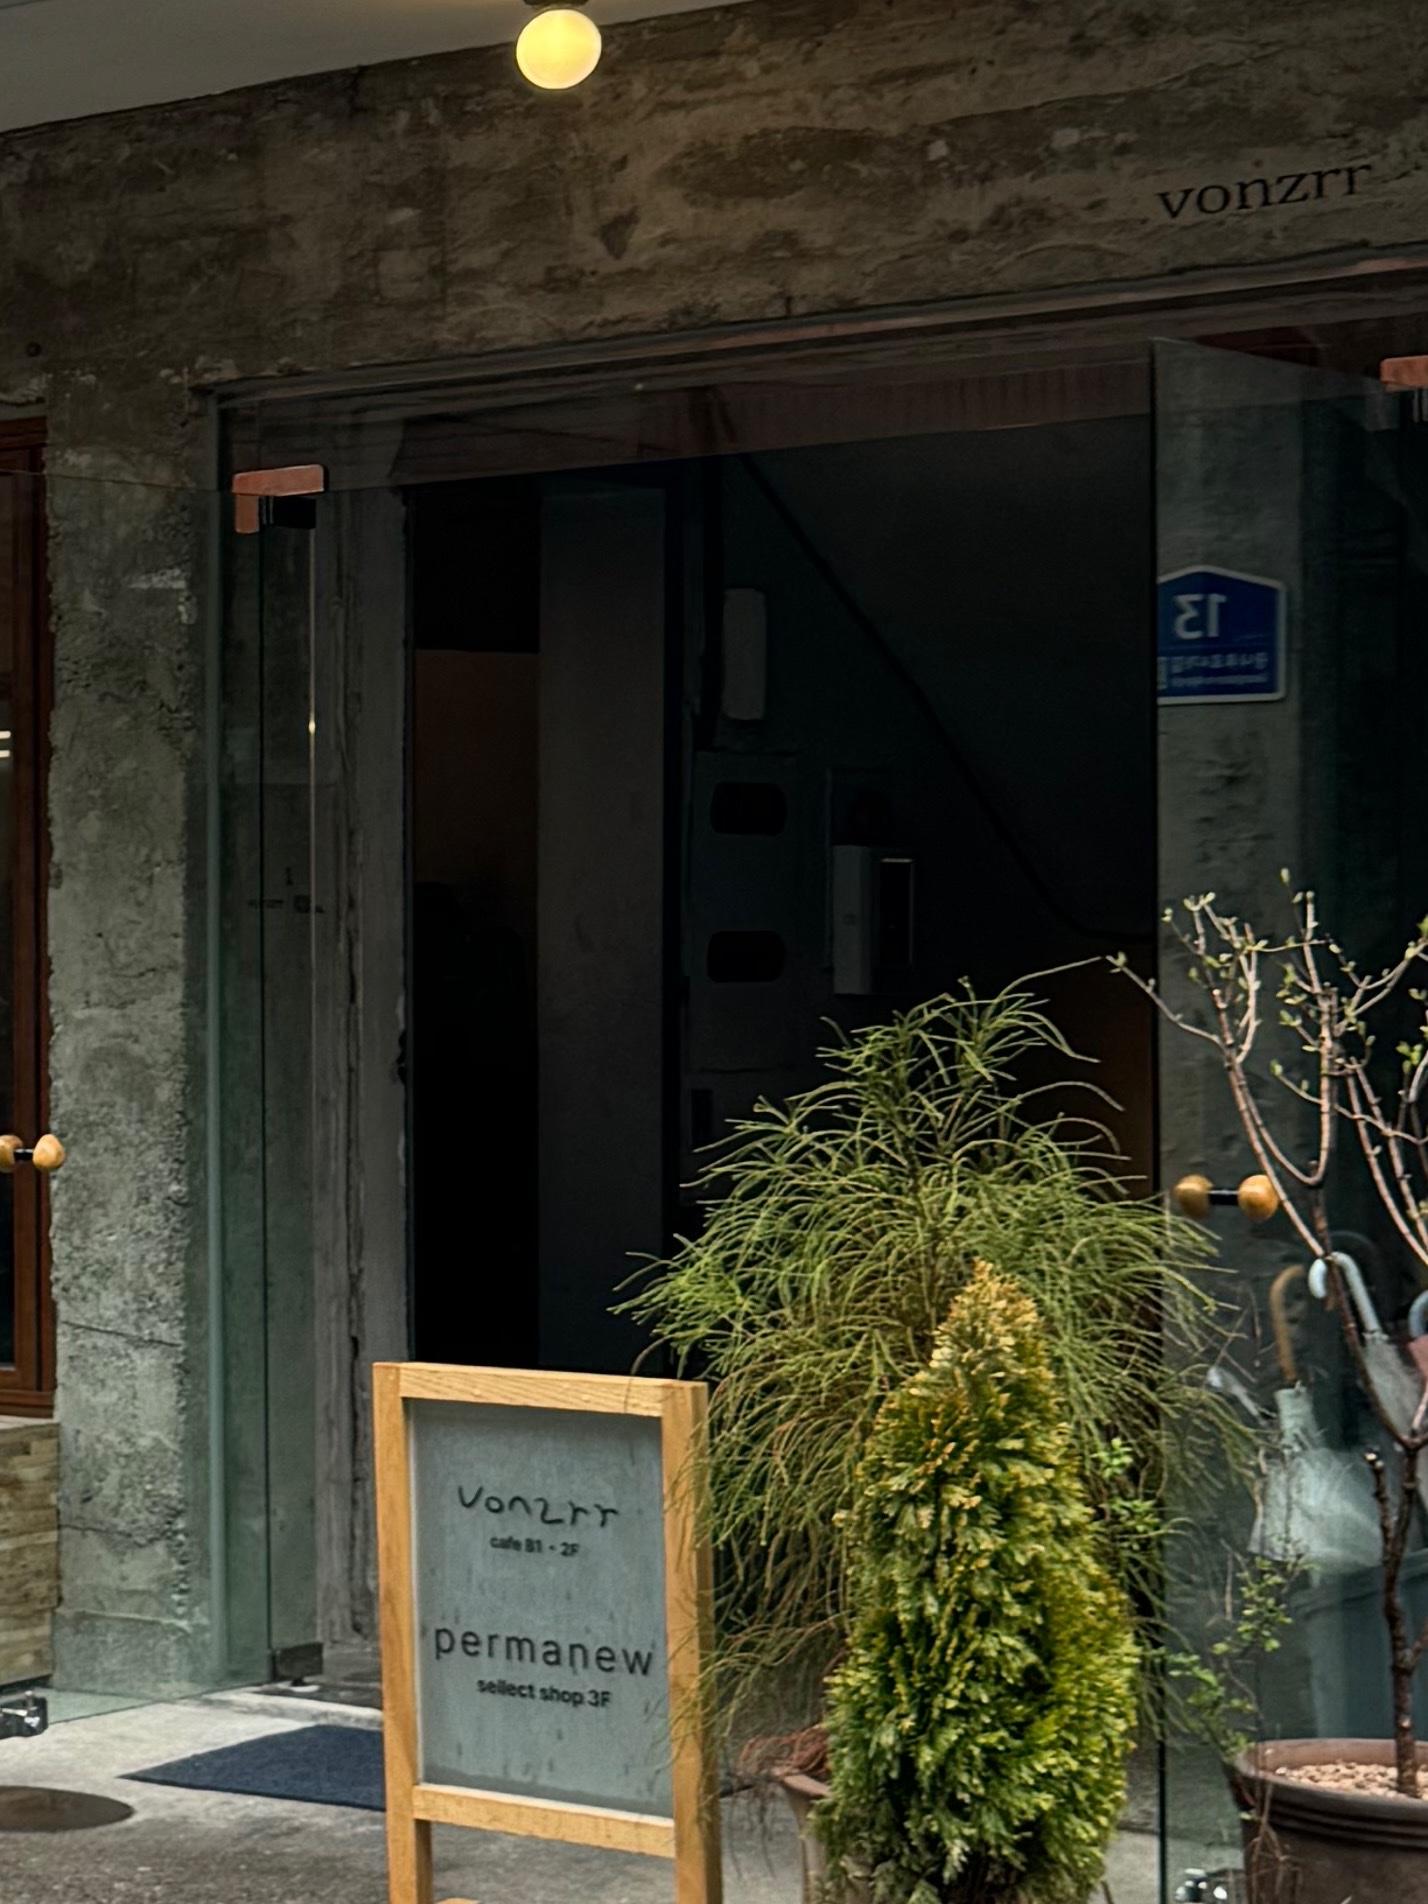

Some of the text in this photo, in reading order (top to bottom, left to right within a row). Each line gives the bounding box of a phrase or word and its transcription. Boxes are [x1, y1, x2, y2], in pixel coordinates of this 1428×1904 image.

[1156, 164, 1372, 219] vonzrr
[435, 1627, 653, 1676] permanew
[539, 1685, 585, 1707] shop
[587, 1689, 612, 1708] 3F
